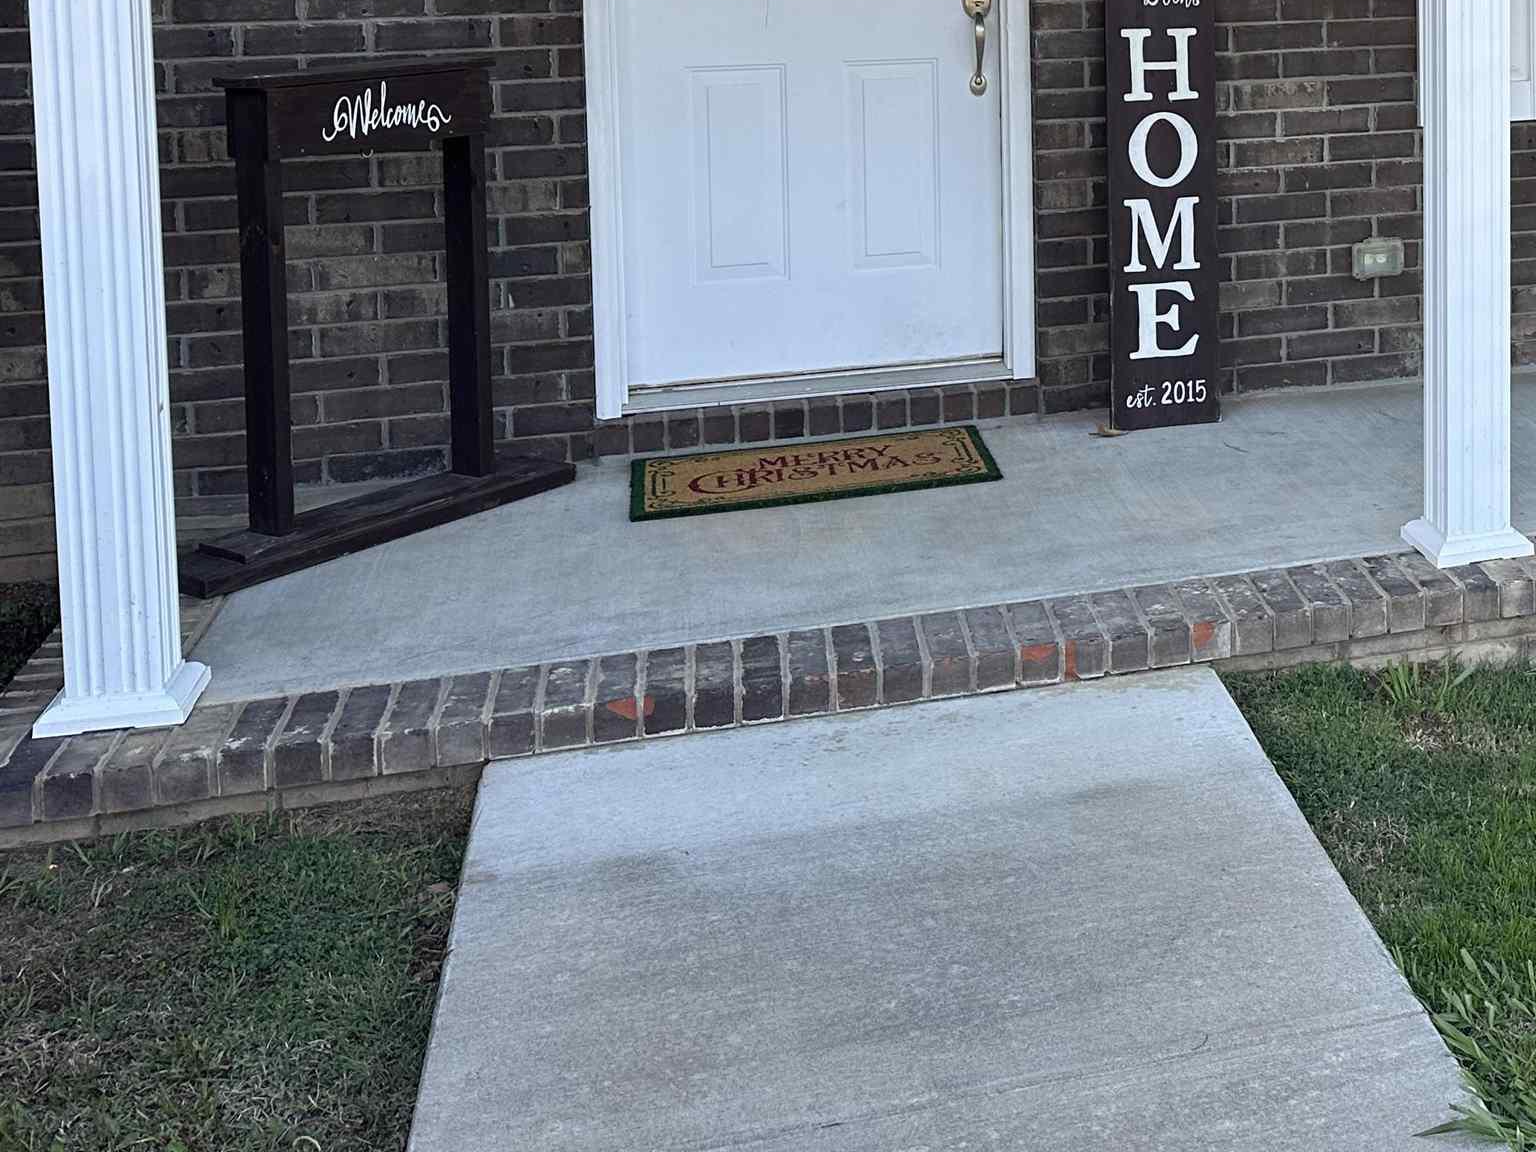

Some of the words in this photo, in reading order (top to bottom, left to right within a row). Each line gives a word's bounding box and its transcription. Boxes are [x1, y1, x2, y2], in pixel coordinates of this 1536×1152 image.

[322, 80, 451, 142] Welcome
[1120, 27, 1201, 360] HOME
[1126, 384, 1157, 409] est.
[1161, 379, 1207, 404] 2015
[687, 451, 942, 495] CHRISTMAS
[759, 444, 891, 470] MERRY
